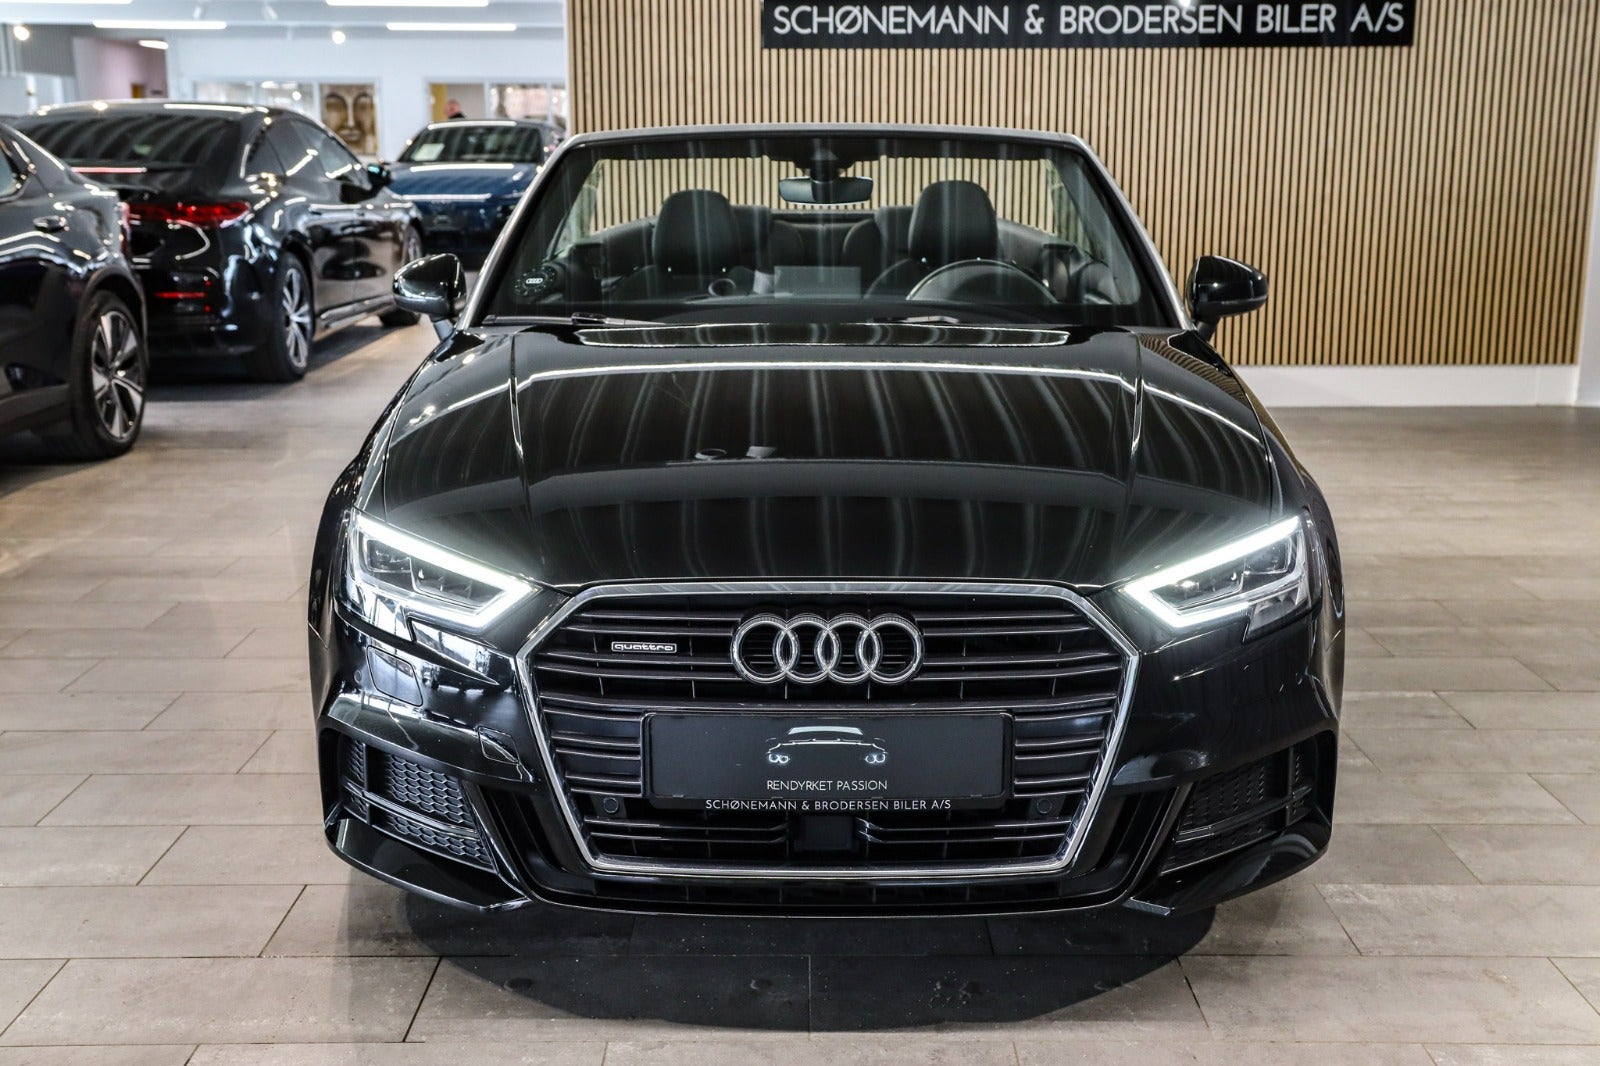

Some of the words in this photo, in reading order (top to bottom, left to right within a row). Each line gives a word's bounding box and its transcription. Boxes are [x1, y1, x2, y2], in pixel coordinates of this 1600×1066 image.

[773, 5, 1009, 35] SCHØNEMANN
[1024, 4, 1045, 35] &
[1059, 3, 1243, 35] BRODERSEN
[1256, 3, 1337, 33] BILER
[1350, 2, 1404, 32] A/S
[614, 643, 674, 651] quattro
[766, 780, 833, 791] RENDYRKET
[836, 780, 888, 791] PASSION
[705, 799, 797, 810] SCHØNEMANN
[801, 800, 810, 810] &
[814, 800, 889, 810] BRODERSEN
[893, 800, 927, 810] BILER
[931, 799, 951, 809] A/S
